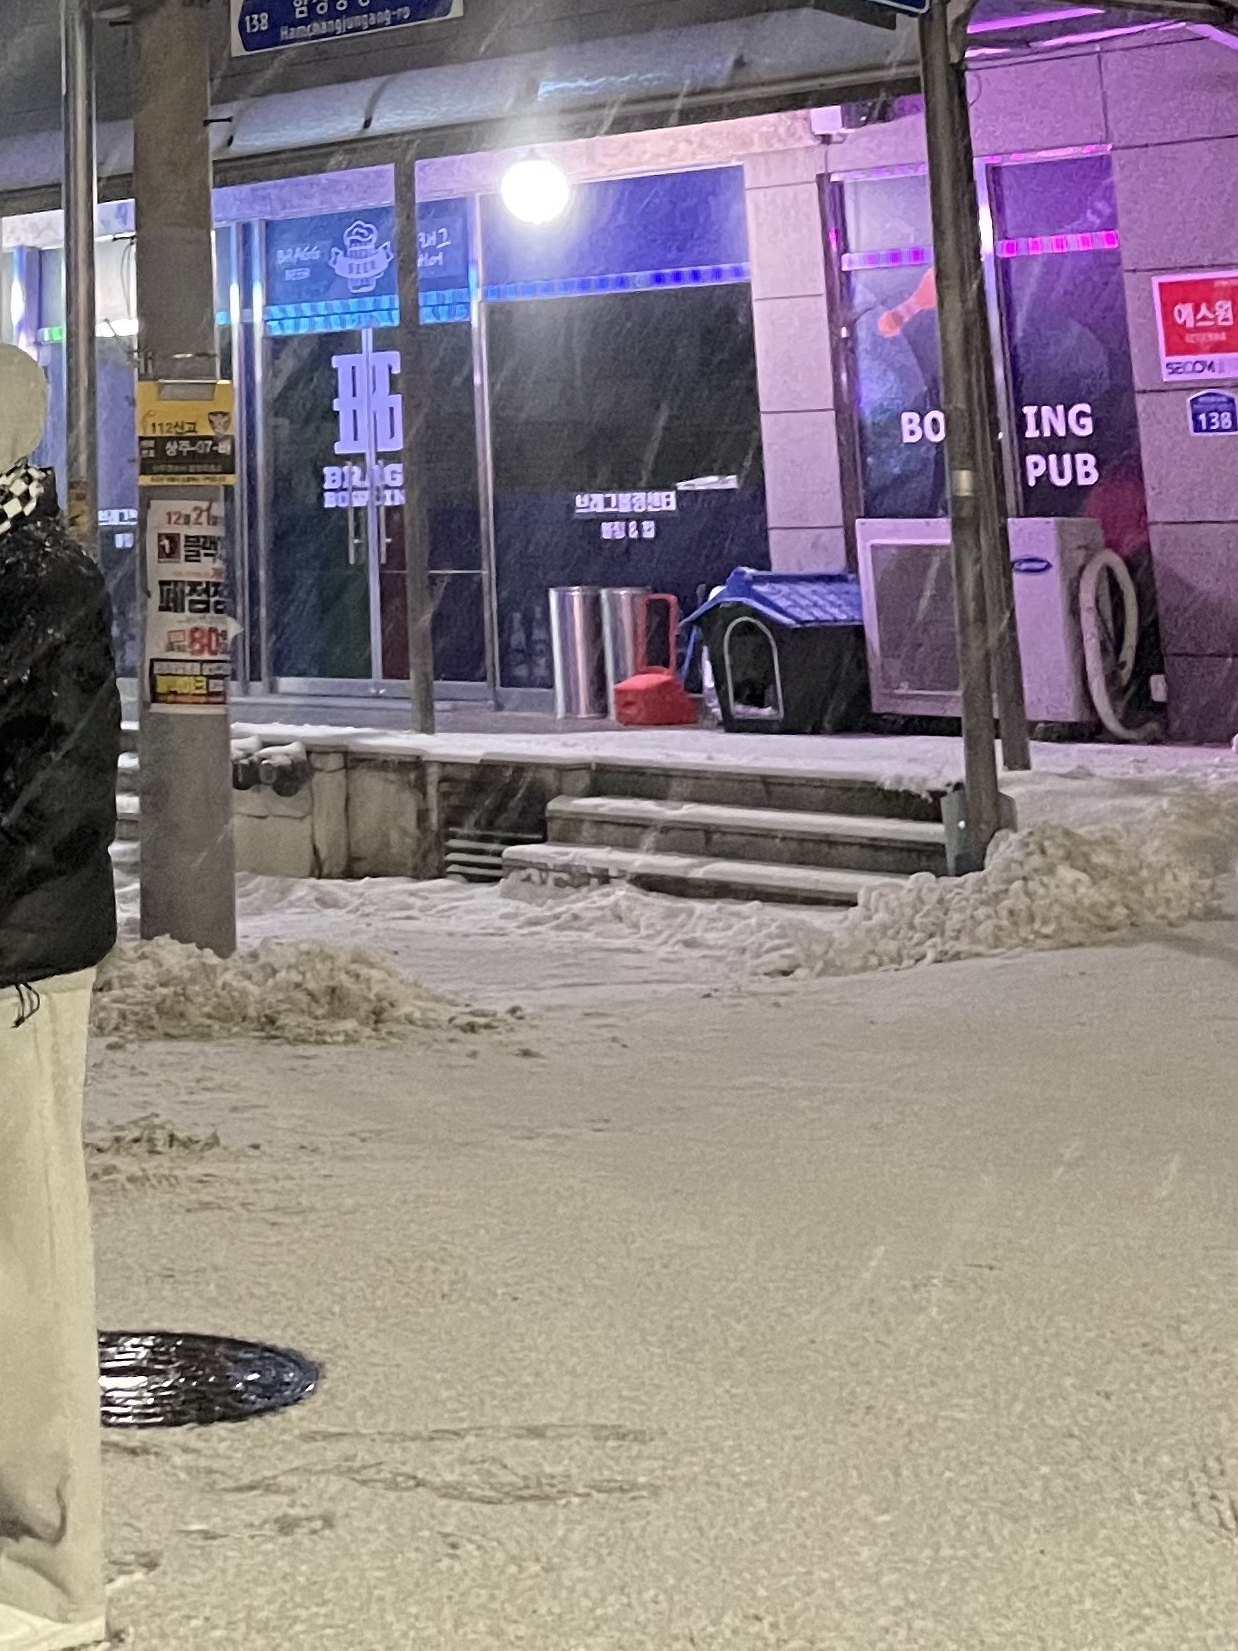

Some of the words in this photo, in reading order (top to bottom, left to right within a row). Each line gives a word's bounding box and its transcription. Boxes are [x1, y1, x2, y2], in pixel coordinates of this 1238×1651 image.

[245, 12, 269, 34] 138
[1173, 300, 1234, 328] 에스원
[1197, 412, 1233, 431] 138
[1025, 453, 1100, 487] PUB
